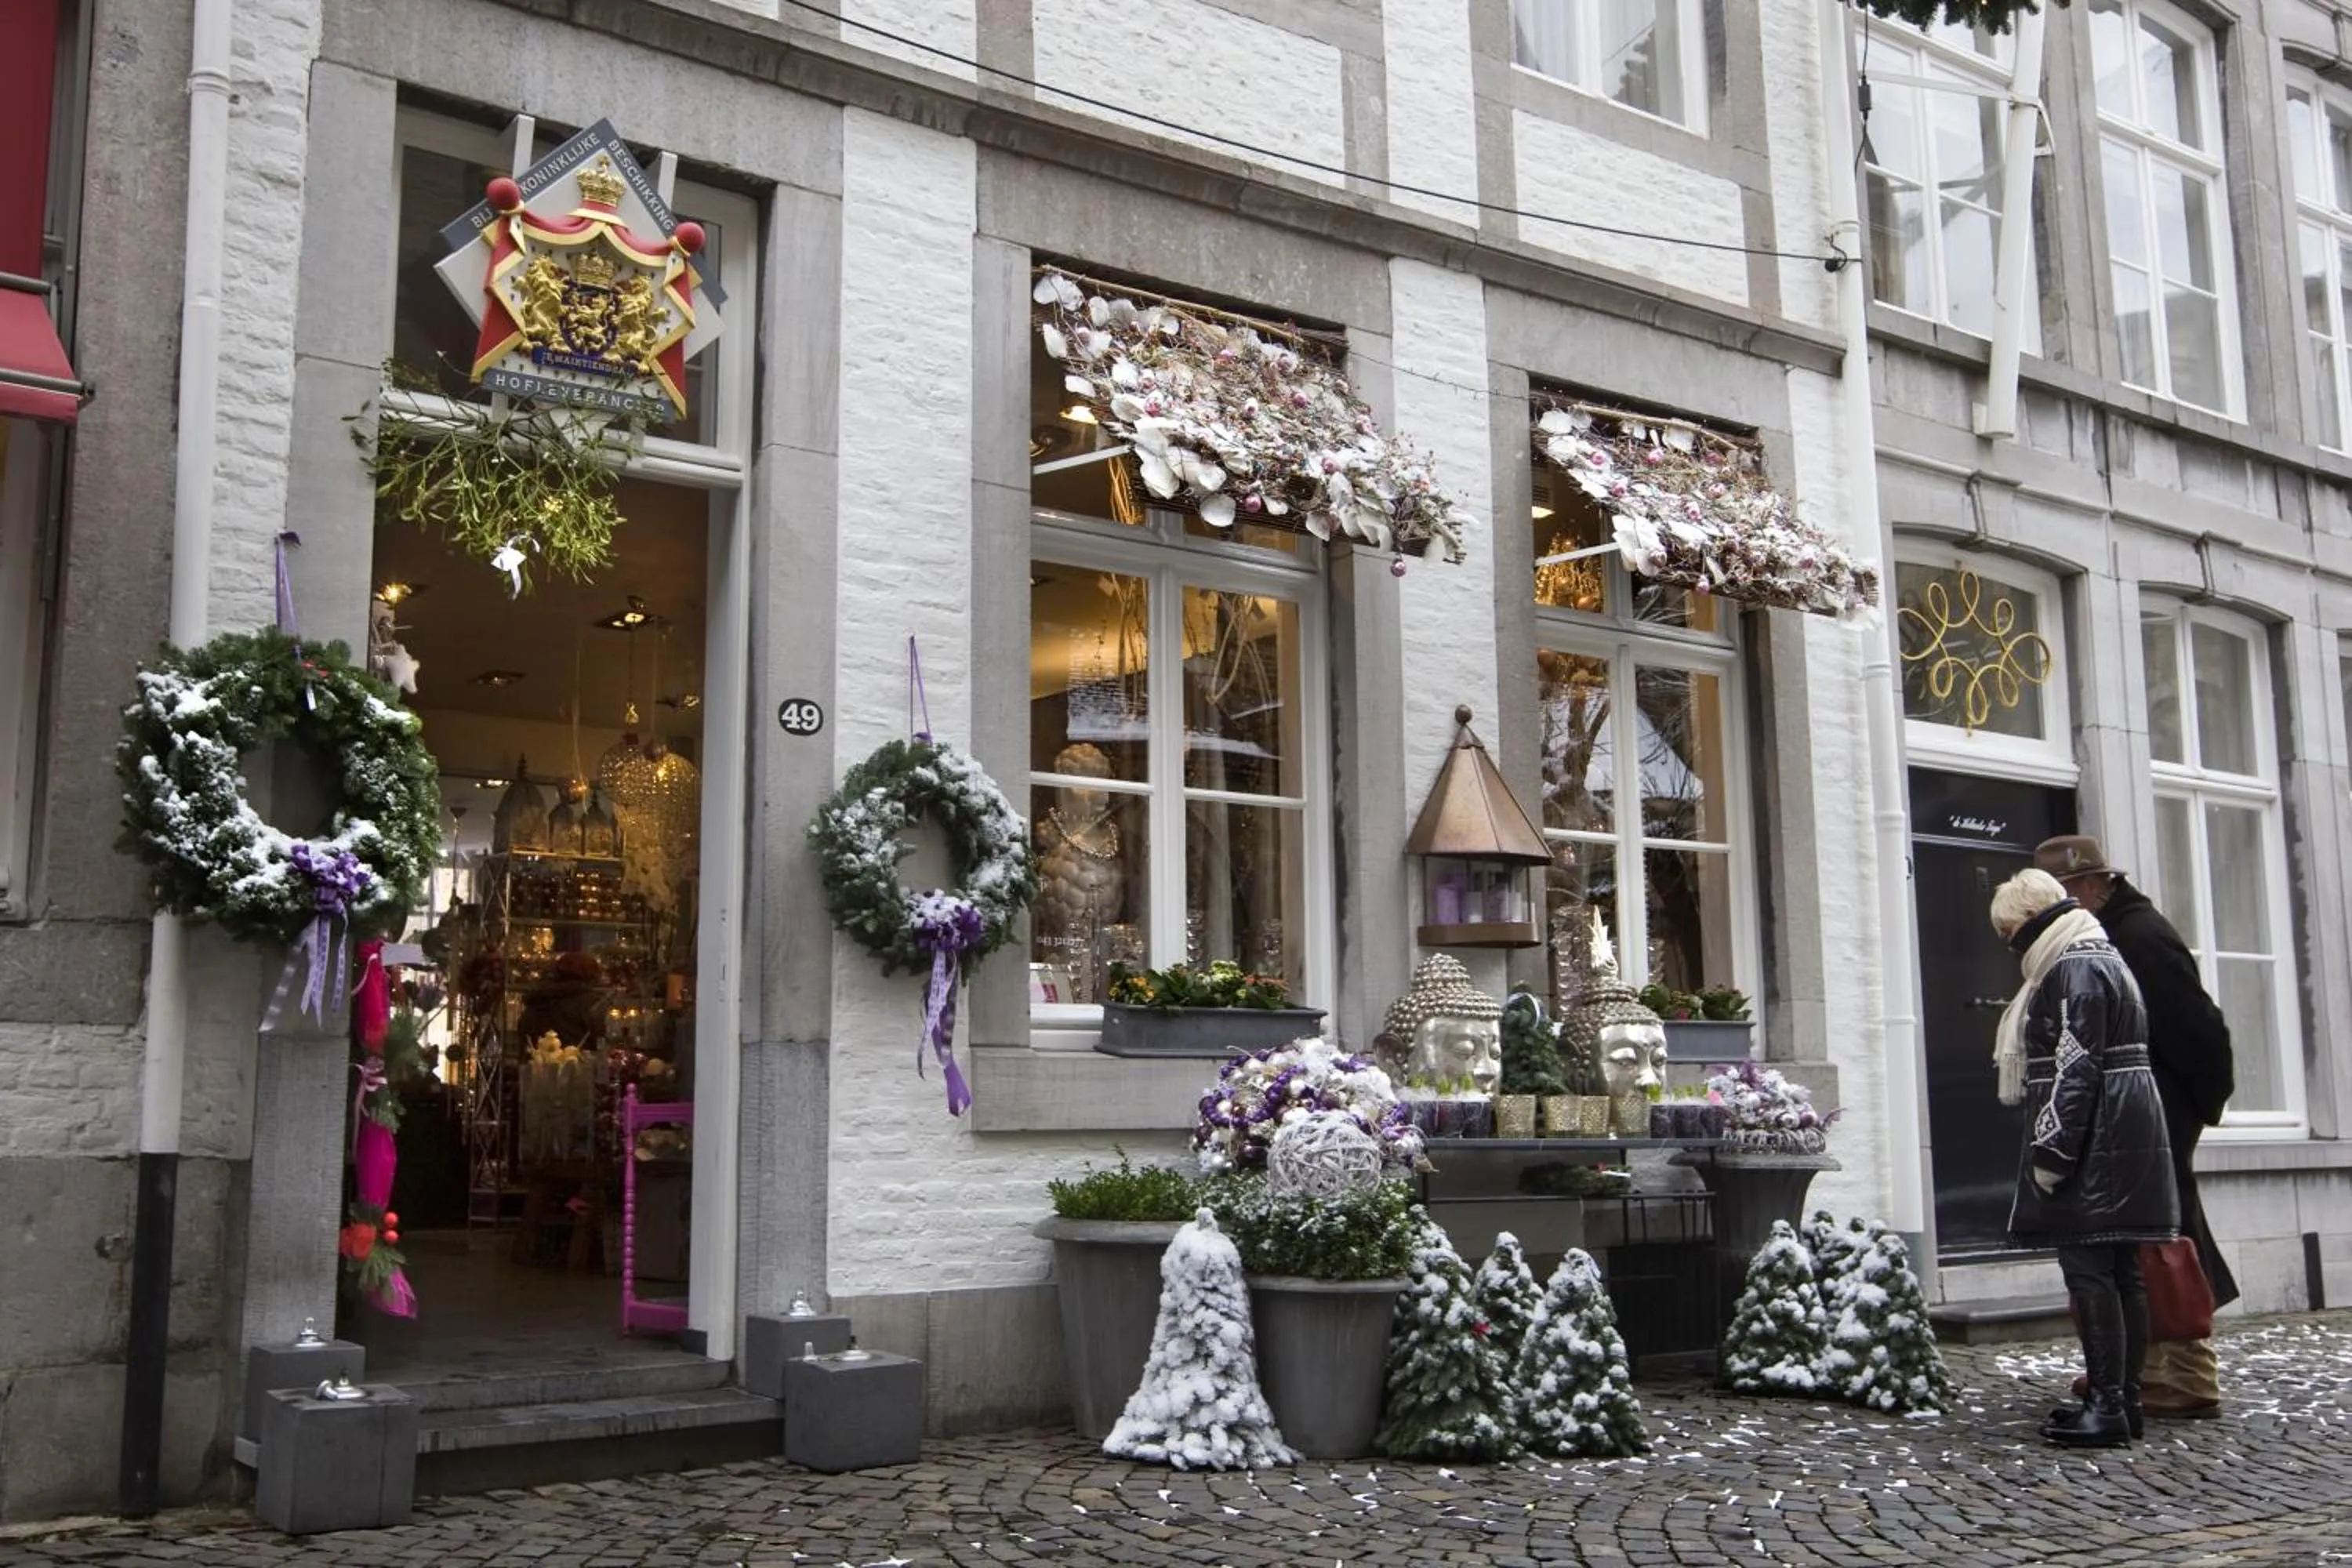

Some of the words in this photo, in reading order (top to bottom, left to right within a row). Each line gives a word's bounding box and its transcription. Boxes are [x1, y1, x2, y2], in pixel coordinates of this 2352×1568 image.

[470, 209, 494, 228] BIJ
[521, 132, 601, 194] KONINKLIJKE
[608, 140, 674, 230] BESCHIKKING
[782, 702, 819, 731] 49
